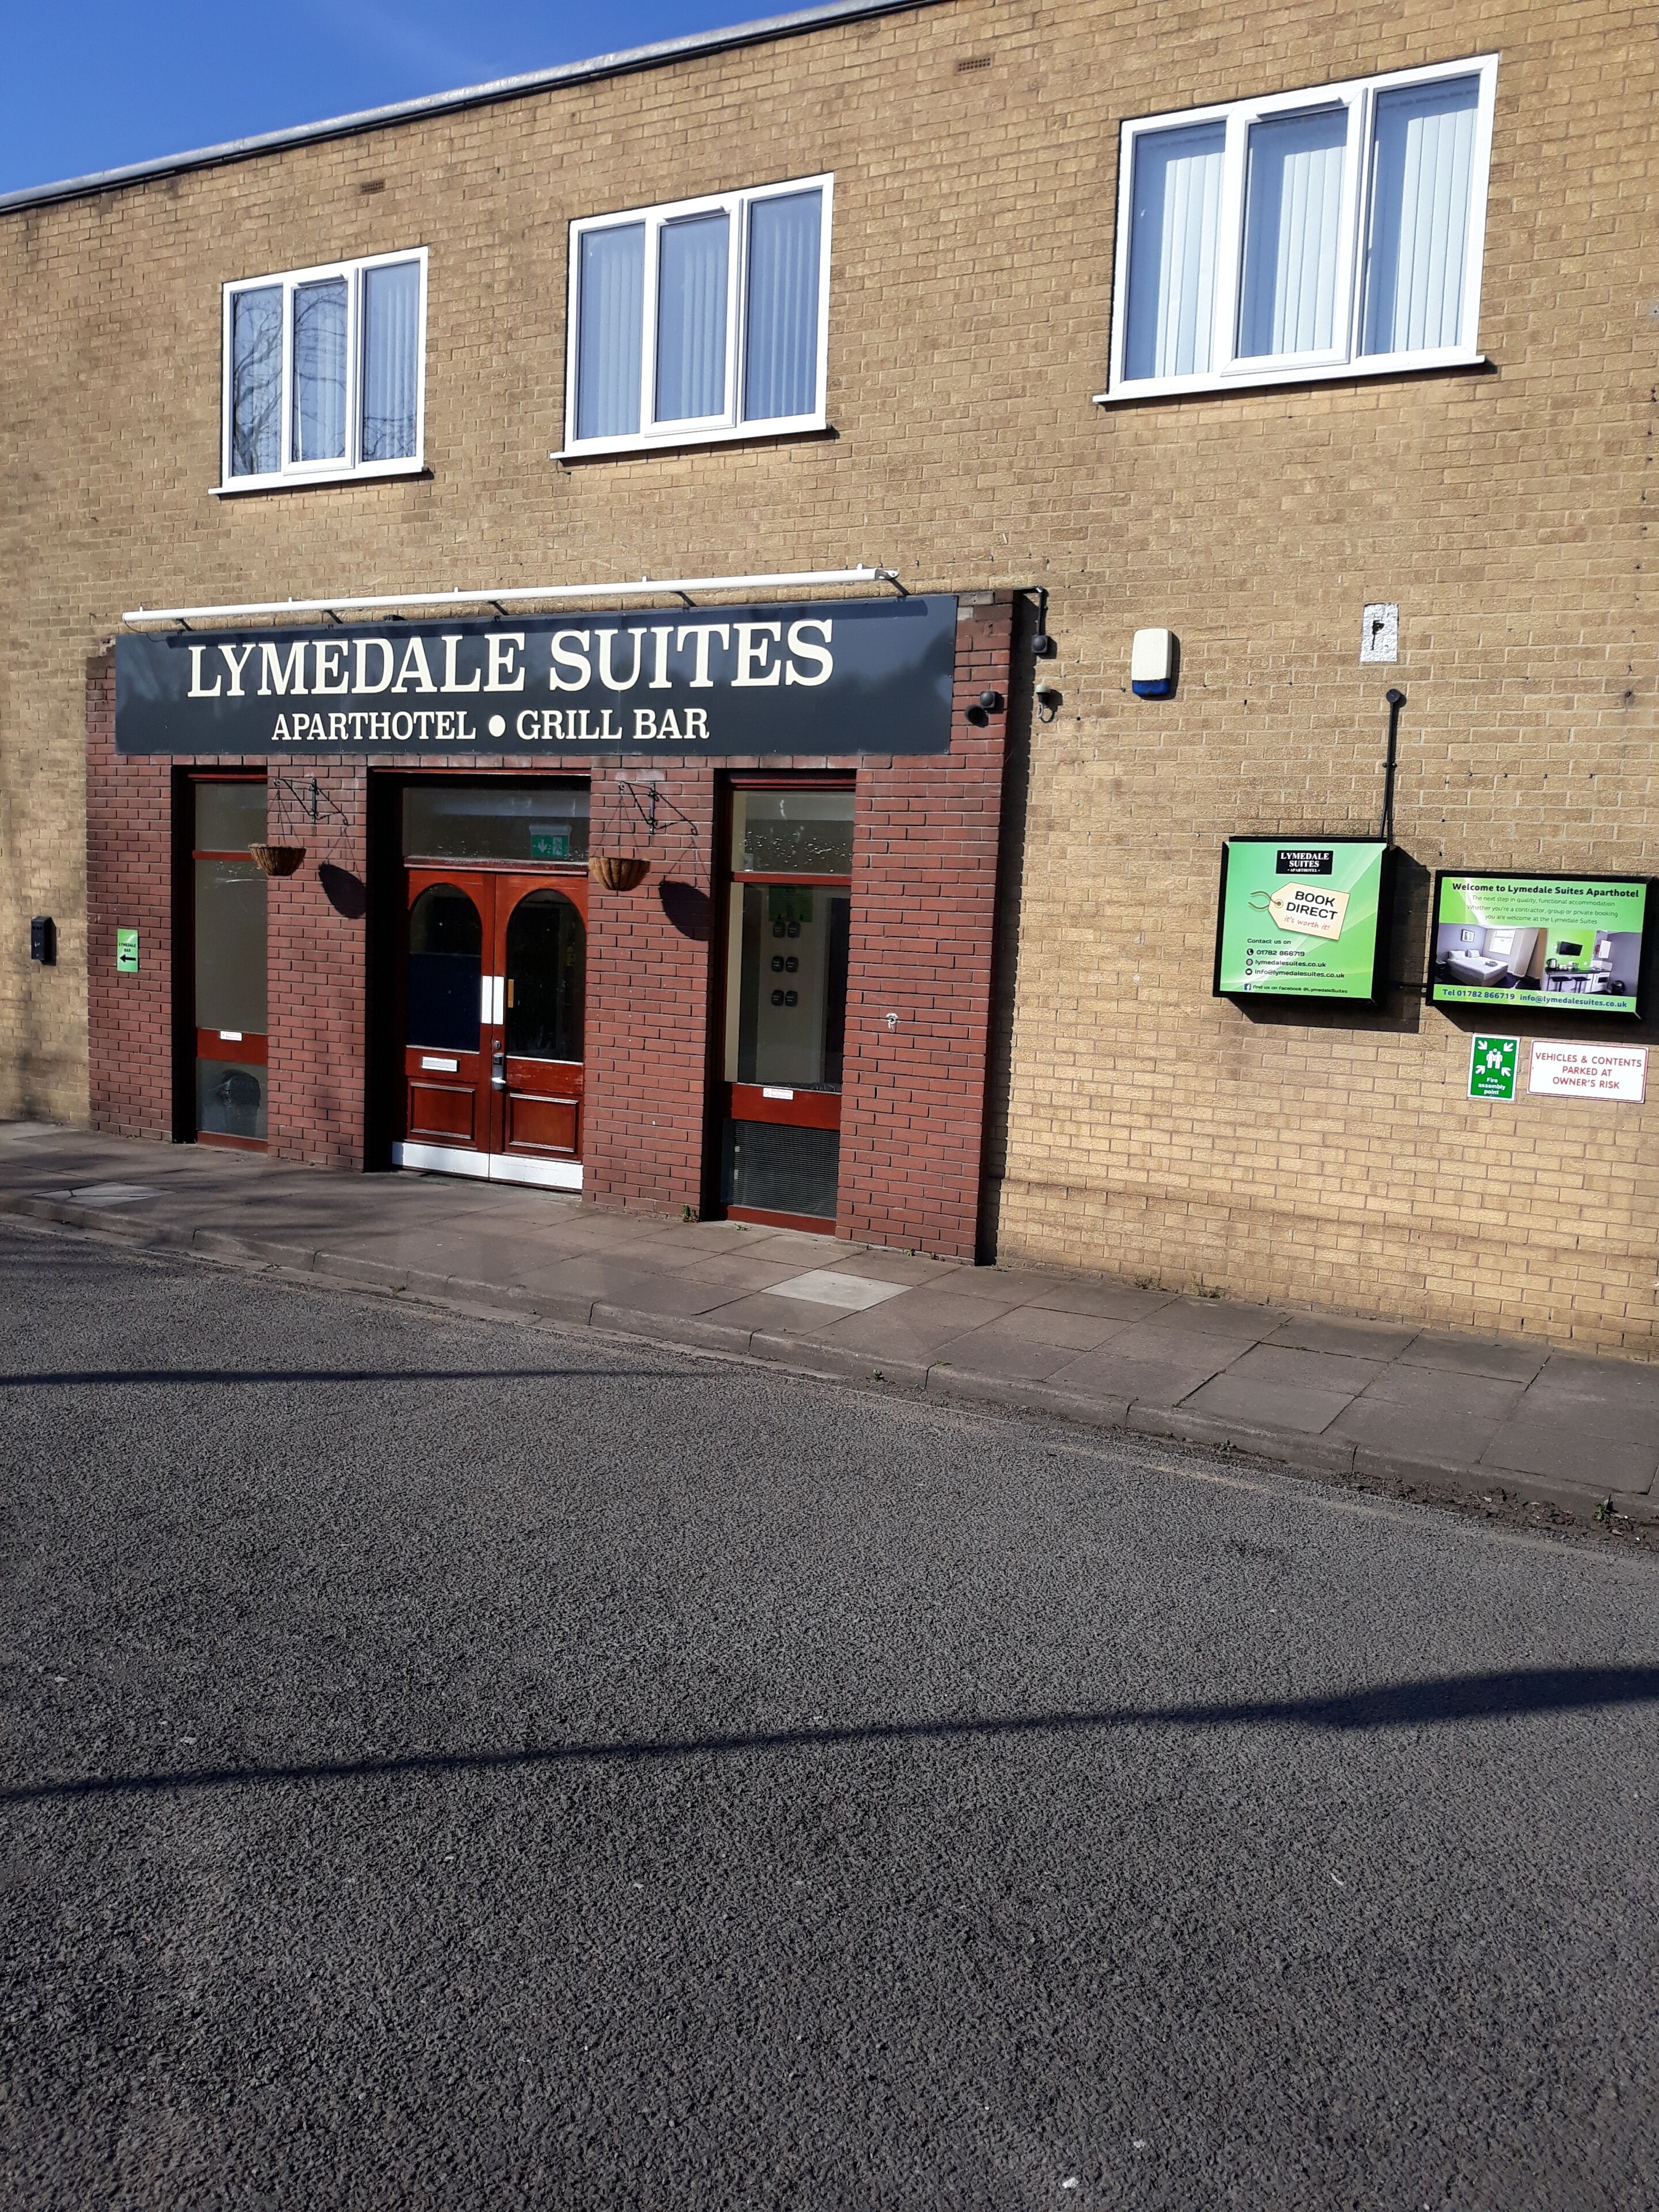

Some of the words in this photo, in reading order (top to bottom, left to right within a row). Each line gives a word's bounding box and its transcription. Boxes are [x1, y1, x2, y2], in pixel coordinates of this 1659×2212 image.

[187, 632, 526, 698] LYMEDALE
[549, 619, 834, 692] SUITES
[271, 711, 476, 741] APARTHOTEL
[516, 709, 623, 741] GRILL
[633, 707, 710, 740] BAR
[1280, 852, 1330, 860] LYMEDALE
[1452, 882, 1494, 892] Welcome
[1508, 885, 1552, 894] Lymedale
[1555, 887, 1584, 895] Suites
[1586, 888, 1639, 897] Aparthotel
[1294, 891, 1336, 907] BOOK
[1286, 902, 1338, 920] DIRECT
[1594, 910, 1619, 918] booking
[1283, 915, 1295, 924] it's
[1297, 919, 1319, 929] worth
[1321, 923, 1331, 931] it!
[1255, 959, 1327, 968] lymedalesuites.co.uk
[1255, 968, 1345, 978] info@lymedalesuites.co.uk
[1456, 990, 1482, 998] 01782
[1484, 991, 1515, 1000] 866719
[1520, 993, 1627, 1007] info@lymedalesuites.co.uk
[1535, 1052, 1578, 1063] VEHICLES
[1581, 1055, 1588, 1063] &
[1591, 1056, 1642, 1067] CONTENTS
[1562, 1066, 1598, 1076] PARKED
[1601, 1069, 1612, 1077] AT
[1552, 1076, 1596, 1088] OWNER'S
[1599, 1080, 1620, 1089] RISK
